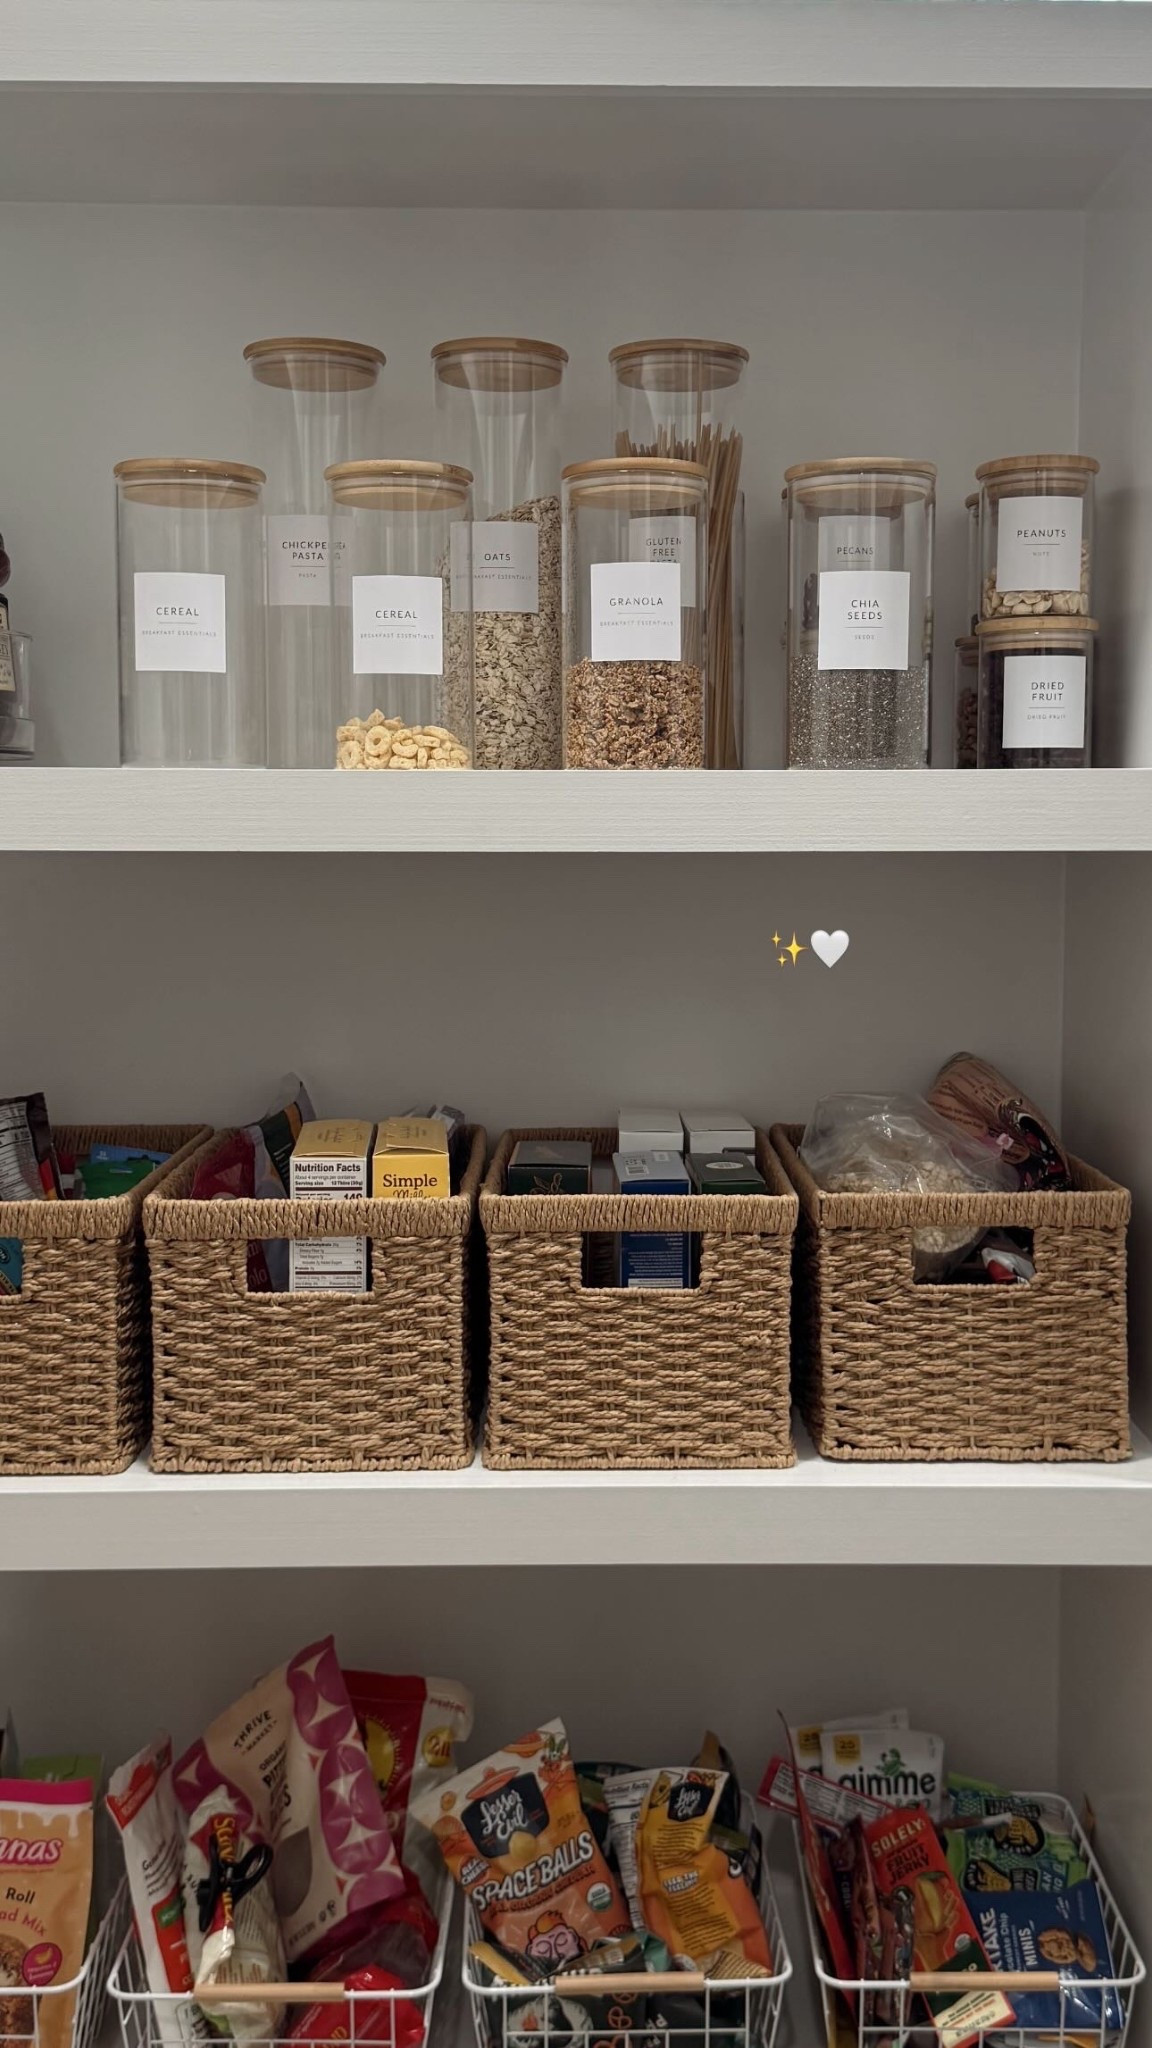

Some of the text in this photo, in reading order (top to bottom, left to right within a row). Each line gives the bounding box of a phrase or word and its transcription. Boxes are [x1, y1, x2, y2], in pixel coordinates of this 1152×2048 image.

[1017, 529, 1067, 538] PEANUTS
[646, 537, 682, 546] GLUTEN
[652, 548, 675, 556] FREE
[836, 547, 873, 555] PECANS
[292, 552, 324, 560] PASTA
[484, 553, 511, 561] OATS
[609, 597, 664, 607] GRANOLA
[851, 600, 880, 608] CHIA
[156, 607, 200, 617] CEREAL
[375, 610, 419, 619] CEREAL
[847, 611, 883, 620] SEEDS
[1031, 682, 1065, 690] DRIED
[1032, 693, 1063, 701] FRUIT
[295, 1163, 361, 1172] Nutrition Facts
[383, 1173, 437, 1189] Simple
[234, 1710, 272, 1748] THRIVE
[871, 1818, 924, 1859] SOLELY
[886, 1843, 926, 1873] FRUIT
[890, 1854, 930, 1885] JERKY
[6, 1887, 36, 1905] Roll
[22, 1914, 48, 1937] Mix
[1000, 1911, 1010, 1936] Chip
[1018, 1926, 1039, 1967] MINIS
